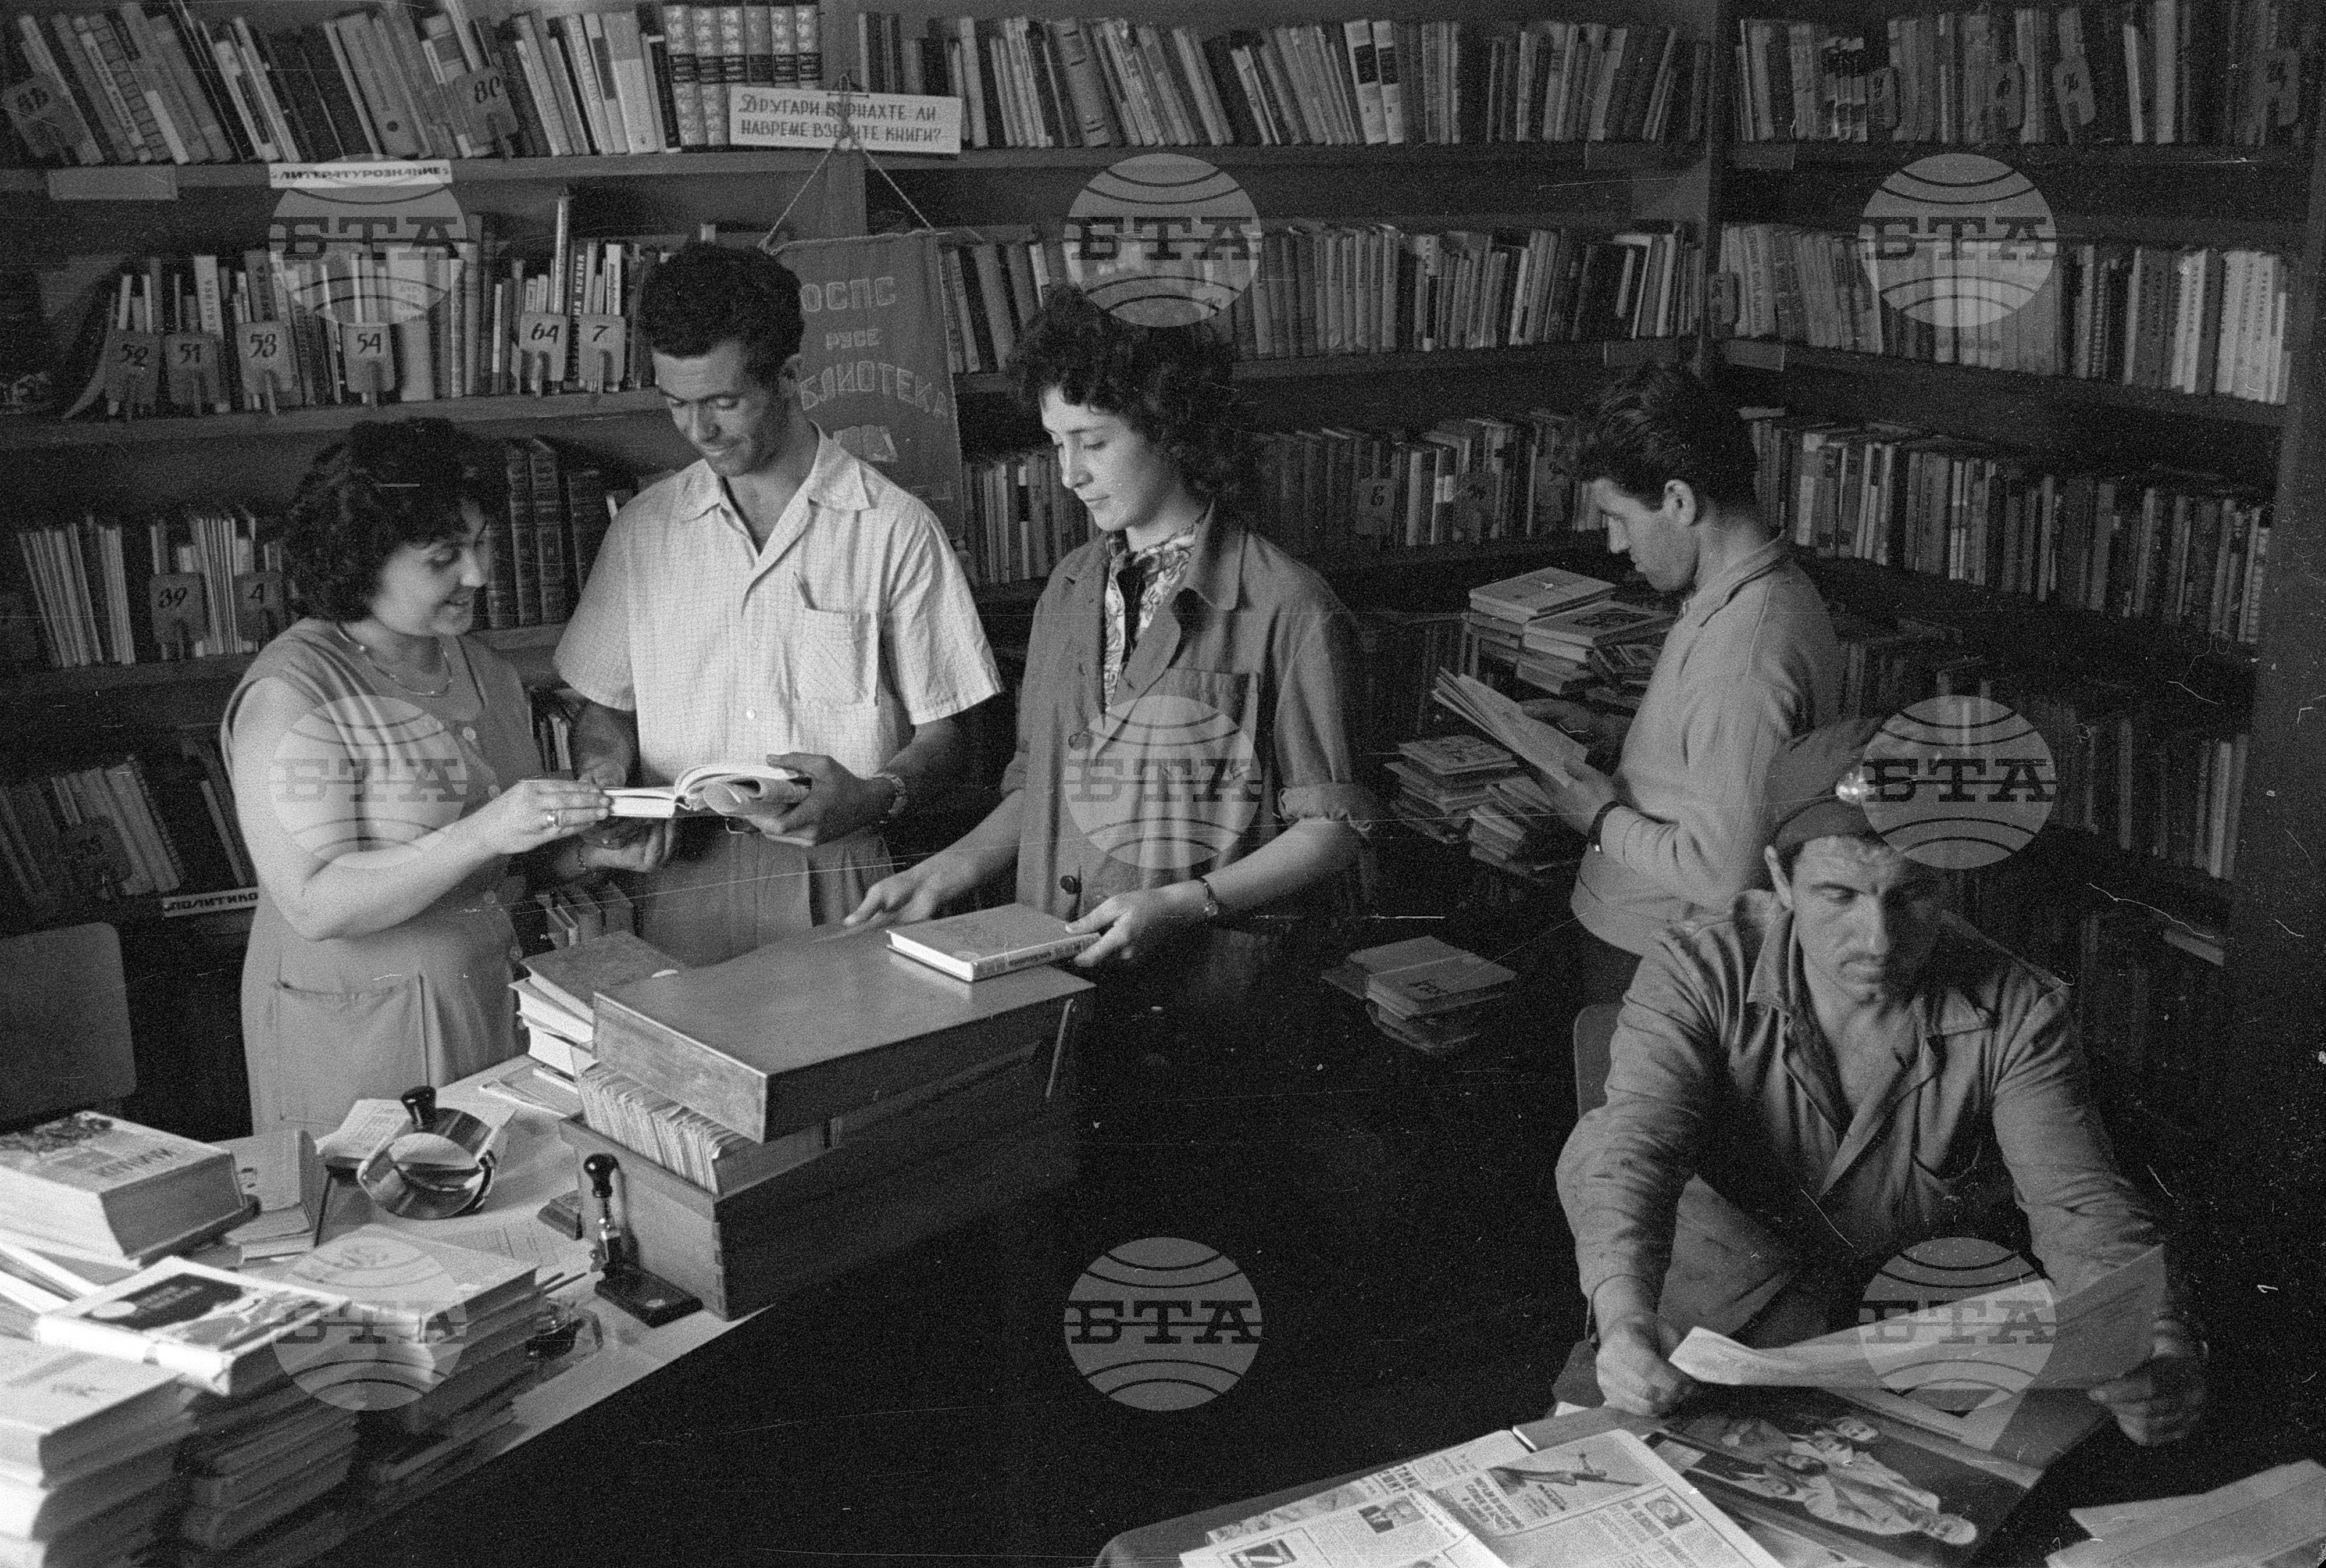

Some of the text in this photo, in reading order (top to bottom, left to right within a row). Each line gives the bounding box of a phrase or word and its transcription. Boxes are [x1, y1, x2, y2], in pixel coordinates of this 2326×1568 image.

[738, 93, 820, 116] ДРУГАРИ
[915, 106, 936, 122] ЛИ
[741, 119, 942, 143] НАВРЕМЕ ВЗЕИТЕ КНИГИ?
[280, 166, 440, 180] ЛИТЕРАТУРОЗНАНИЕ
[800, 276, 896, 312] ОСПС
[356, 333, 381, 354] 54
[530, 322, 559, 343] 64
[592, 325, 610, 342] 7
[826, 328, 879, 349] РУСЕ
[120, 344, 148, 367] 52
[249, 333, 277, 359] 53
[800, 360, 949, 416] БЛИОТЕКА
